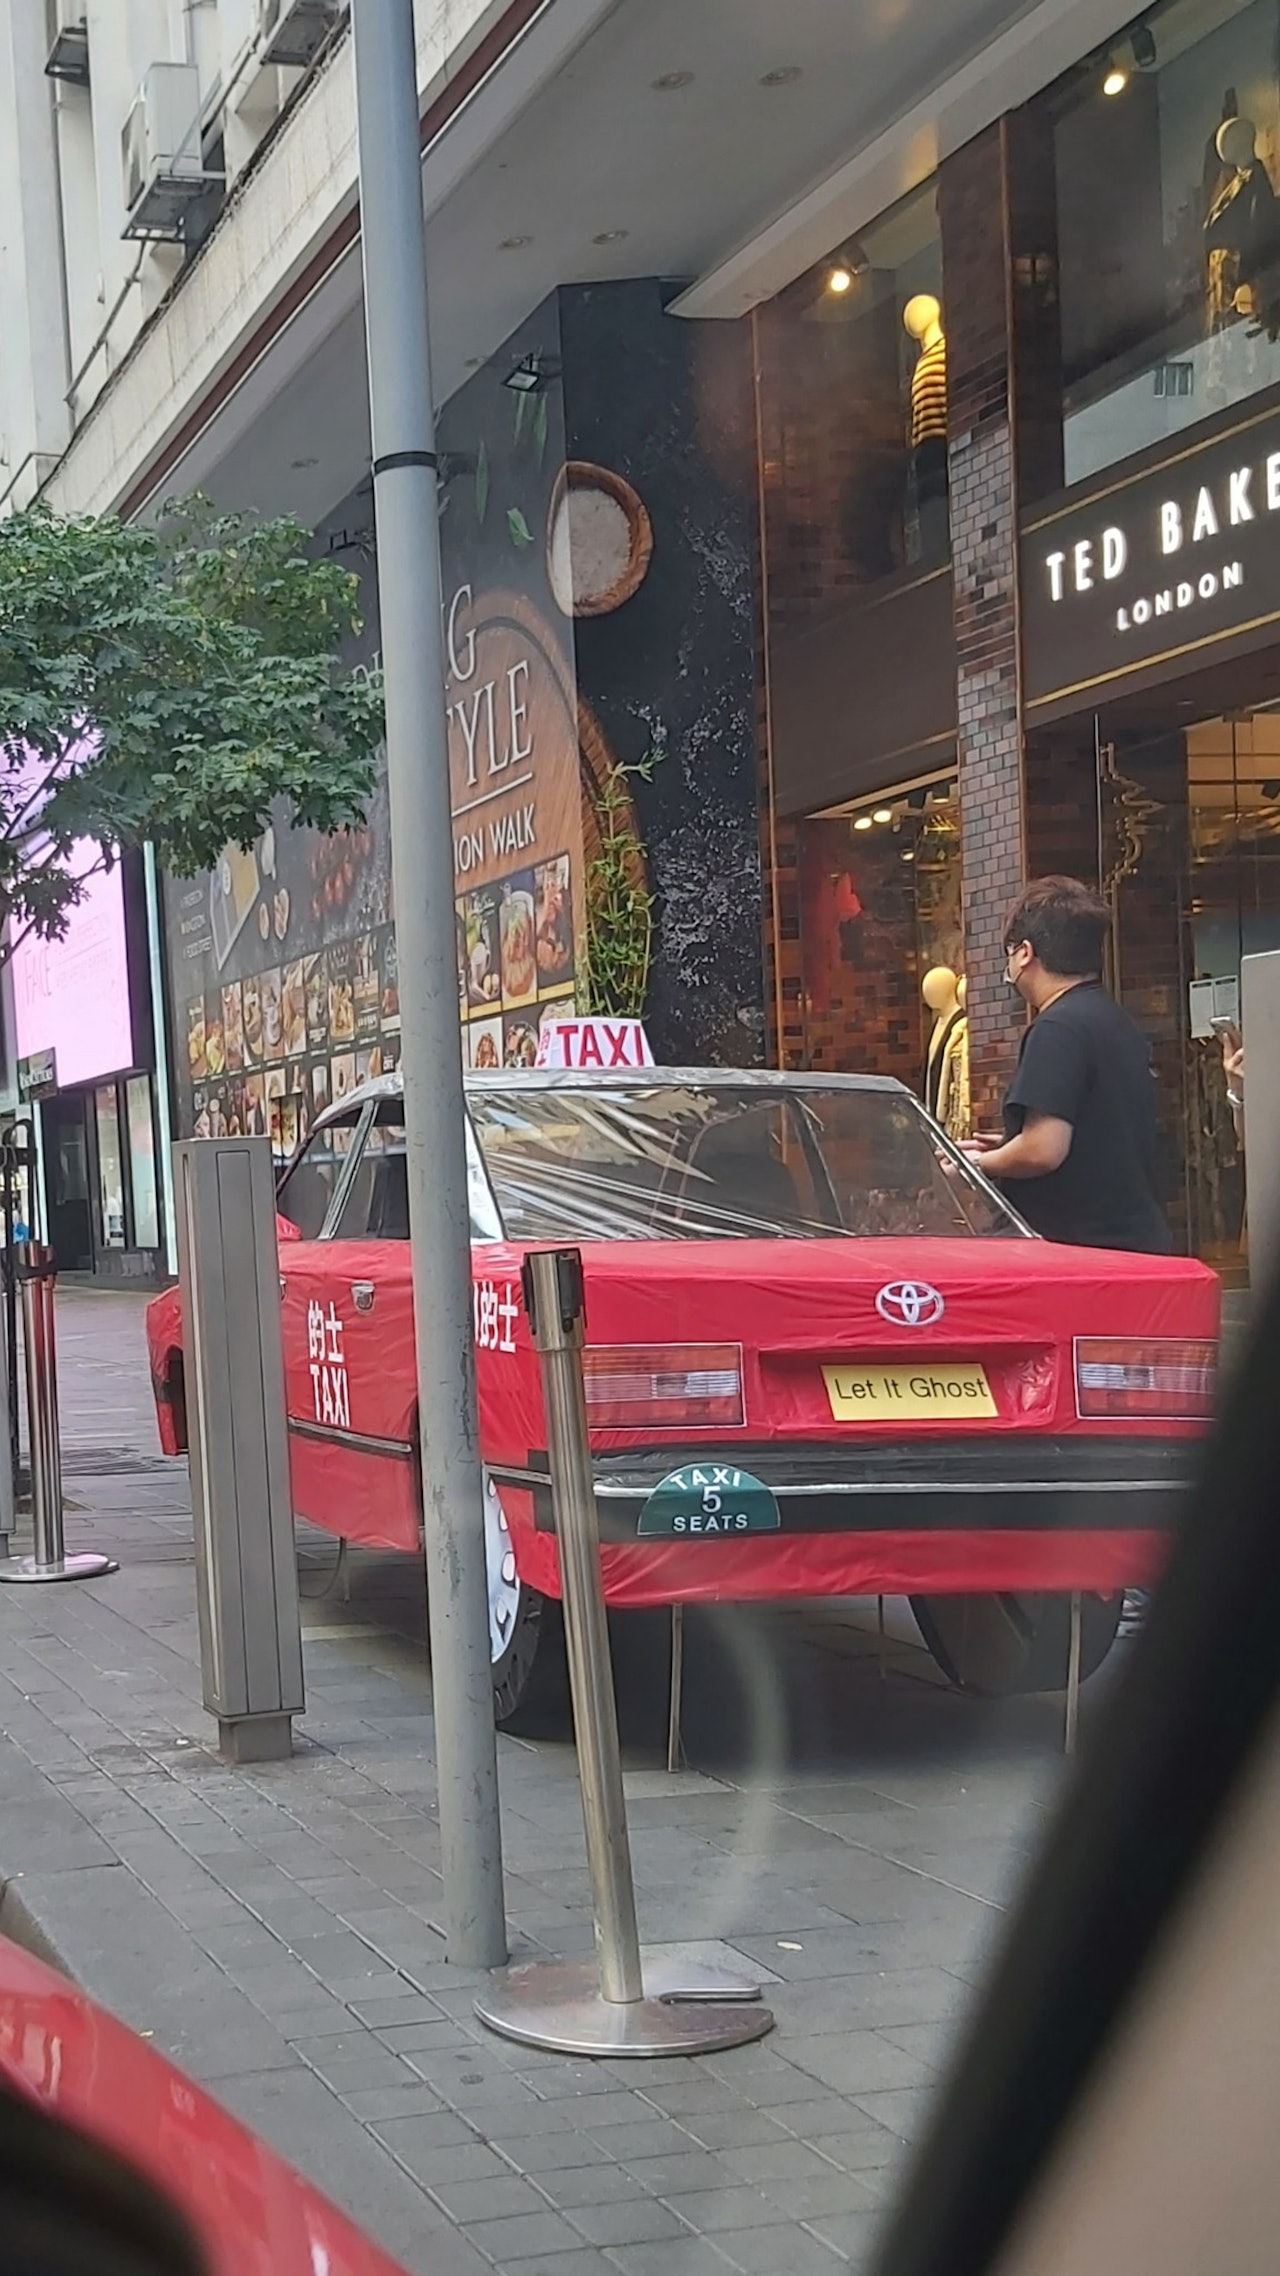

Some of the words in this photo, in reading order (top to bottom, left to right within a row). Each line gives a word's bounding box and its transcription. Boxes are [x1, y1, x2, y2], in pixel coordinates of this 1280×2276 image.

[1046, 526, 1127, 602] TED
[1160, 451, 1280, 555] BAKE
[1116, 561, 1243, 632] LONDON
[446, 659, 533, 787] YLE
[489, 803, 536, 857] WALK
[556, 1024, 645, 1067] TAXI
[308, 1299, 345, 1364] 的士
[310, 1363, 350, 1428] TAXI
[834, 1377, 877, 1400] Let
[884, 1377, 902, 1400] It
[909, 1377, 988, 1400] Ghost
[669, 1466, 741, 1491] TAXI
[701, 1485, 722, 1513] 5
[673, 1513, 749, 1533] SEATS
